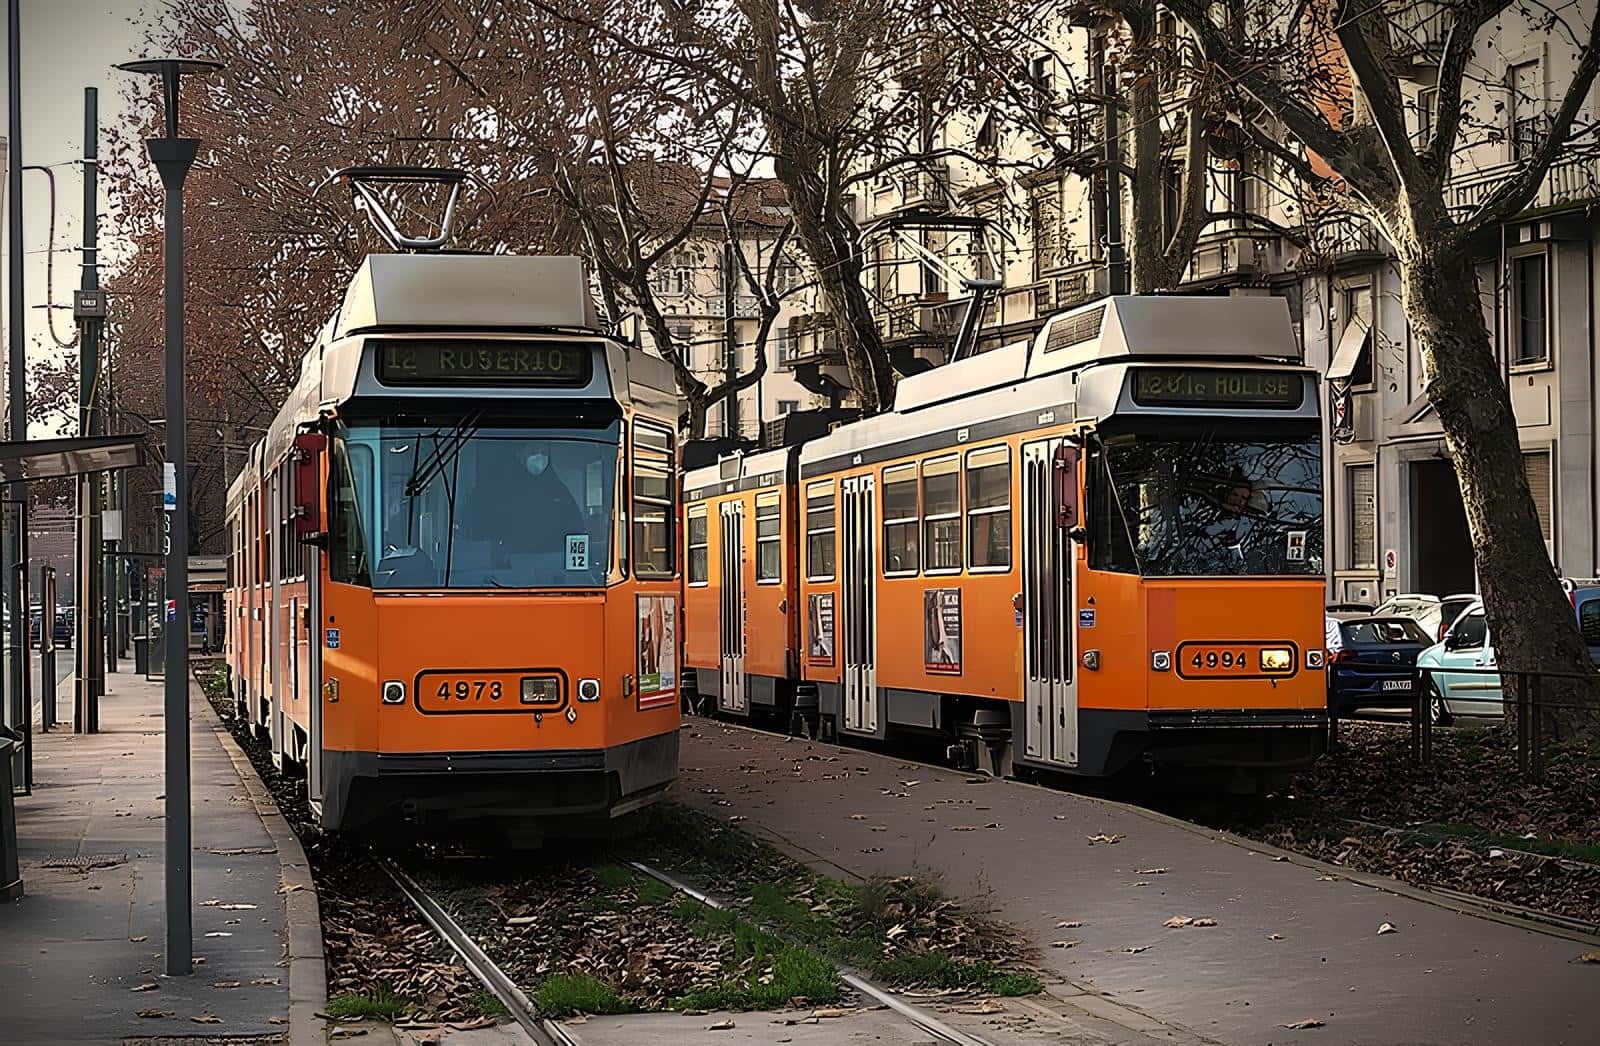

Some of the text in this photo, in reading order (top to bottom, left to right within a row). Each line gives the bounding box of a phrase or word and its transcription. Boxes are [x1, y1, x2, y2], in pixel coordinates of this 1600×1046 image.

[571, 555, 585, 567] 12
[1191, 650, 1247, 669] 4994
[436, 680, 503, 701] 4973
